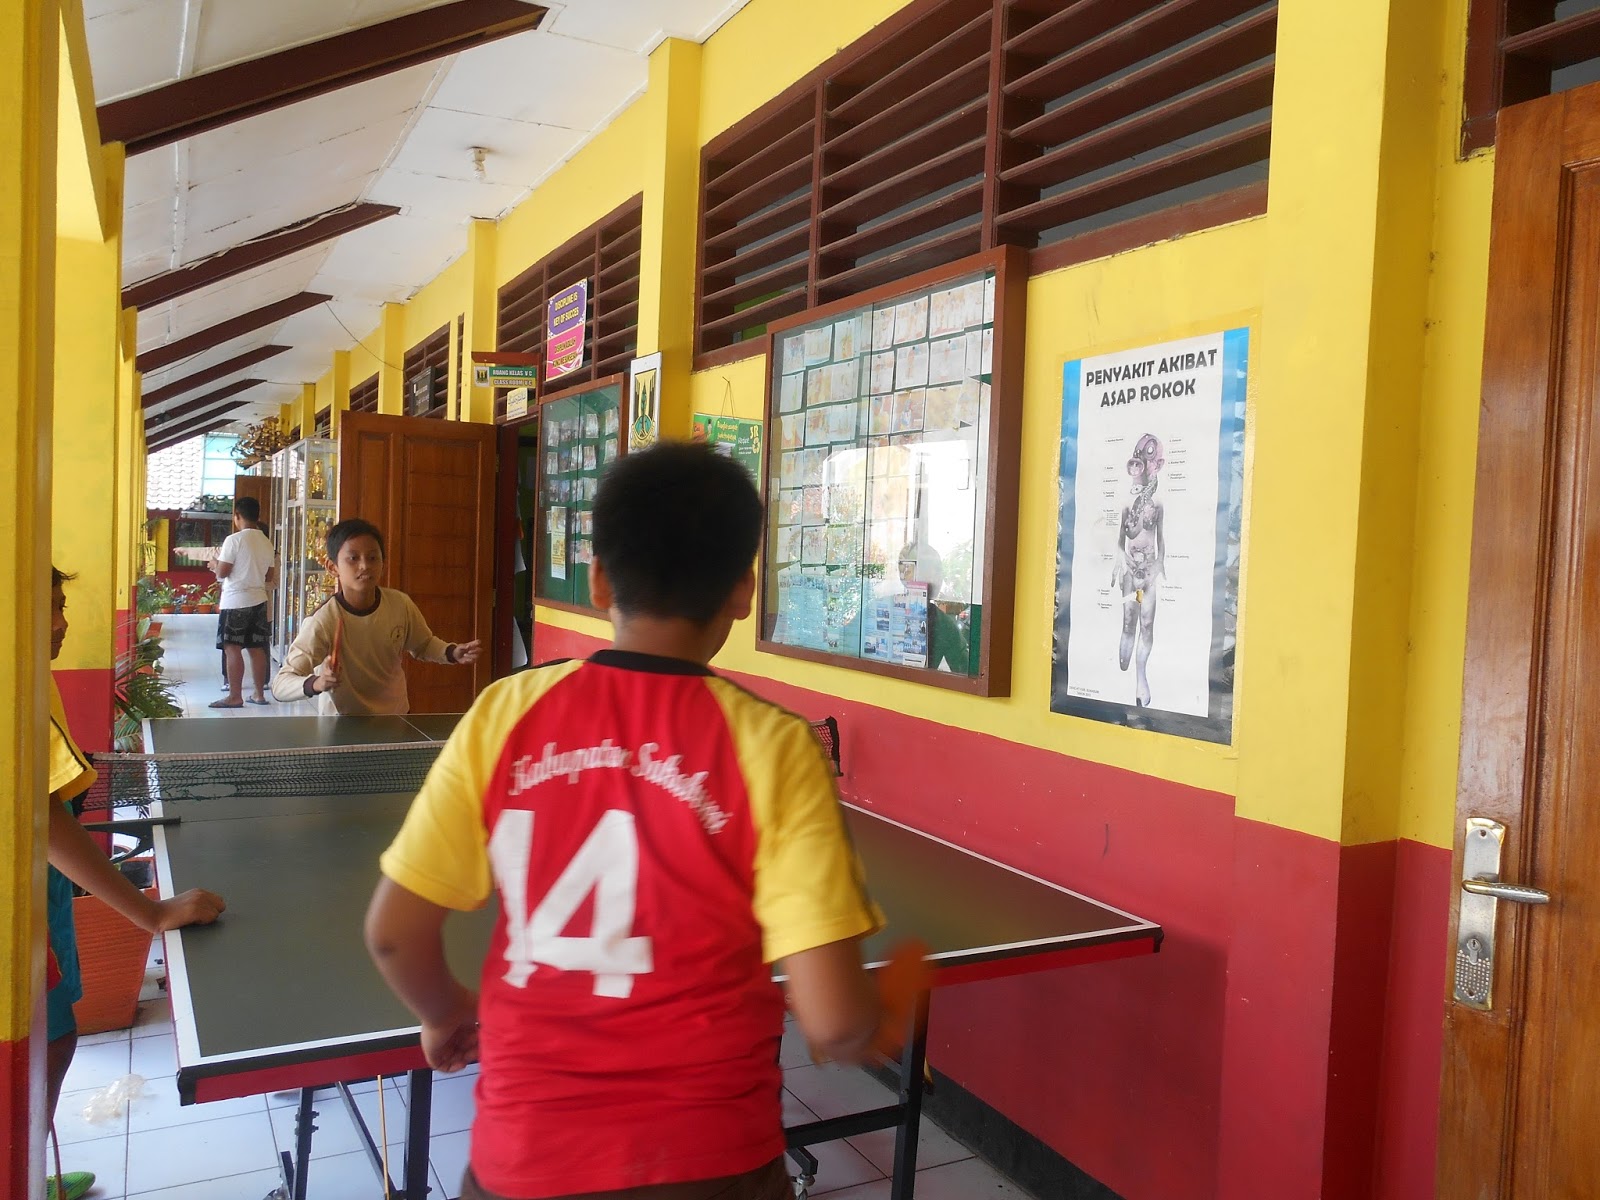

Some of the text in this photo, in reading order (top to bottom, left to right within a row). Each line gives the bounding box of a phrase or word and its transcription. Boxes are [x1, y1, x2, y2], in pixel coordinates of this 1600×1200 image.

[555, 293, 574, 311] DISCIPLINE
[560, 313, 566, 324] OF
[1086, 349, 1217, 387] PENYAKIT AKIBAT
[1100, 378, 1196, 408] ASAP ROKOK
[488, 809, 654, 998] 14
